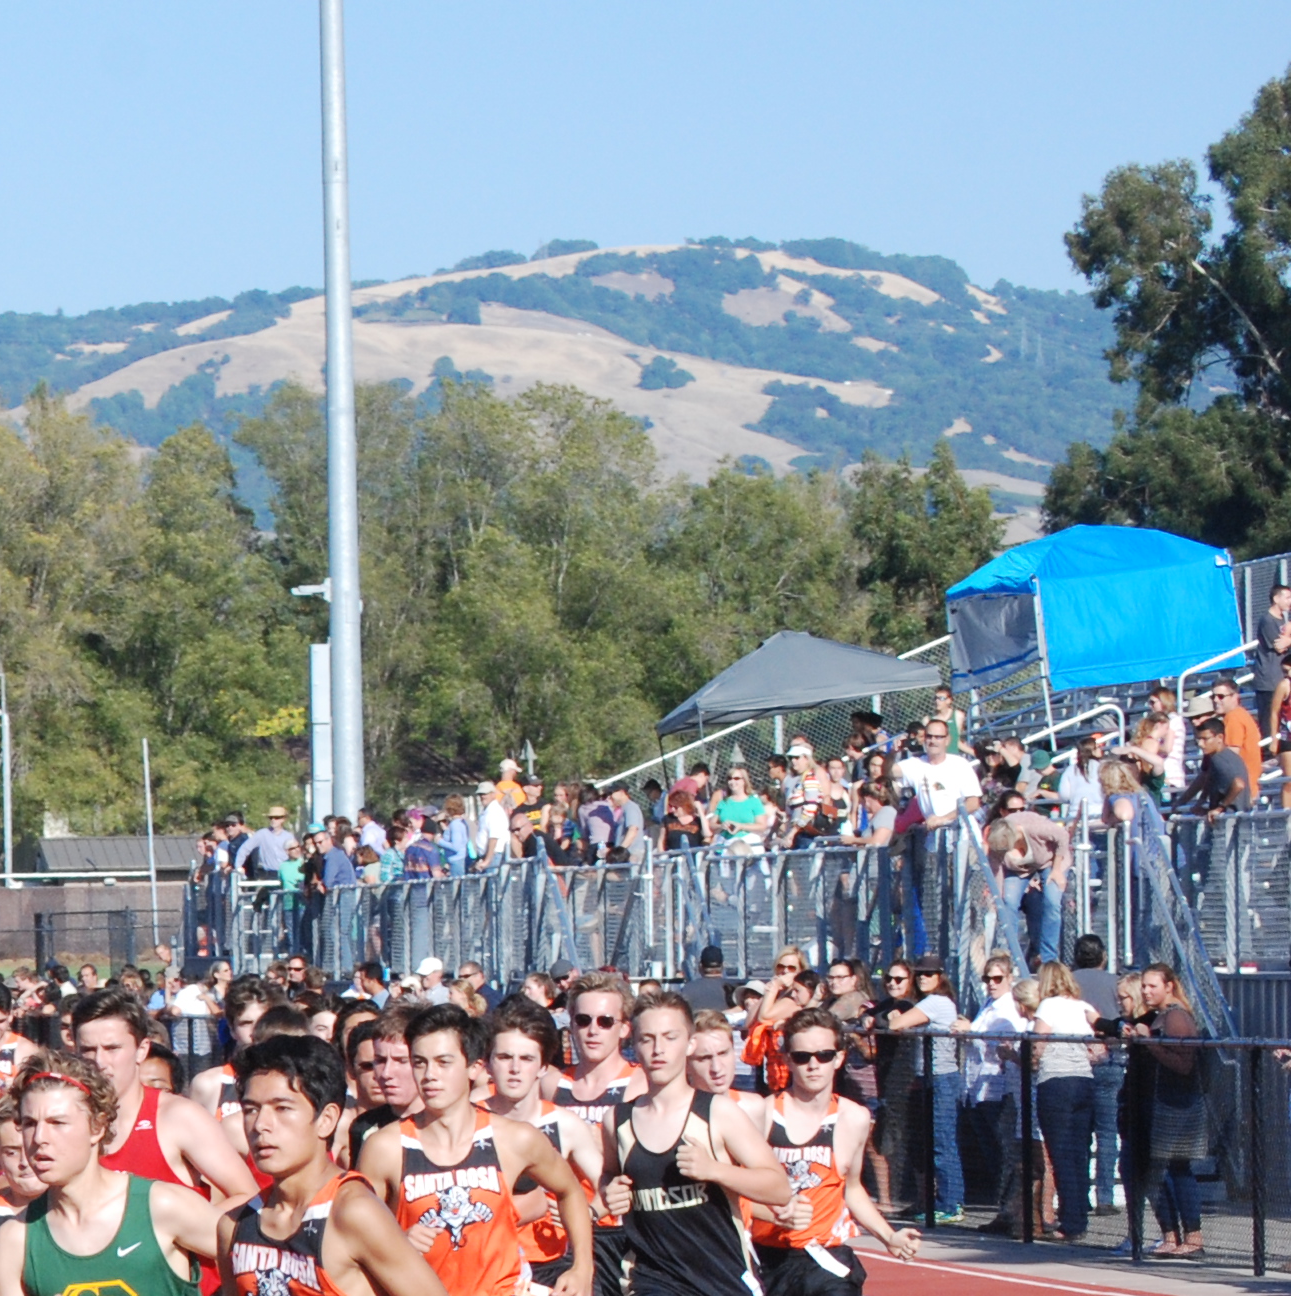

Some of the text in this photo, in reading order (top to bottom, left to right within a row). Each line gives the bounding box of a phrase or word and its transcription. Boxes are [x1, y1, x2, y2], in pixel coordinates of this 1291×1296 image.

[803, 1145, 831, 1168] ROSA
[404, 1165, 501, 1202] SANTA ROSA
[280, 1249, 322, 1292] ROSA
